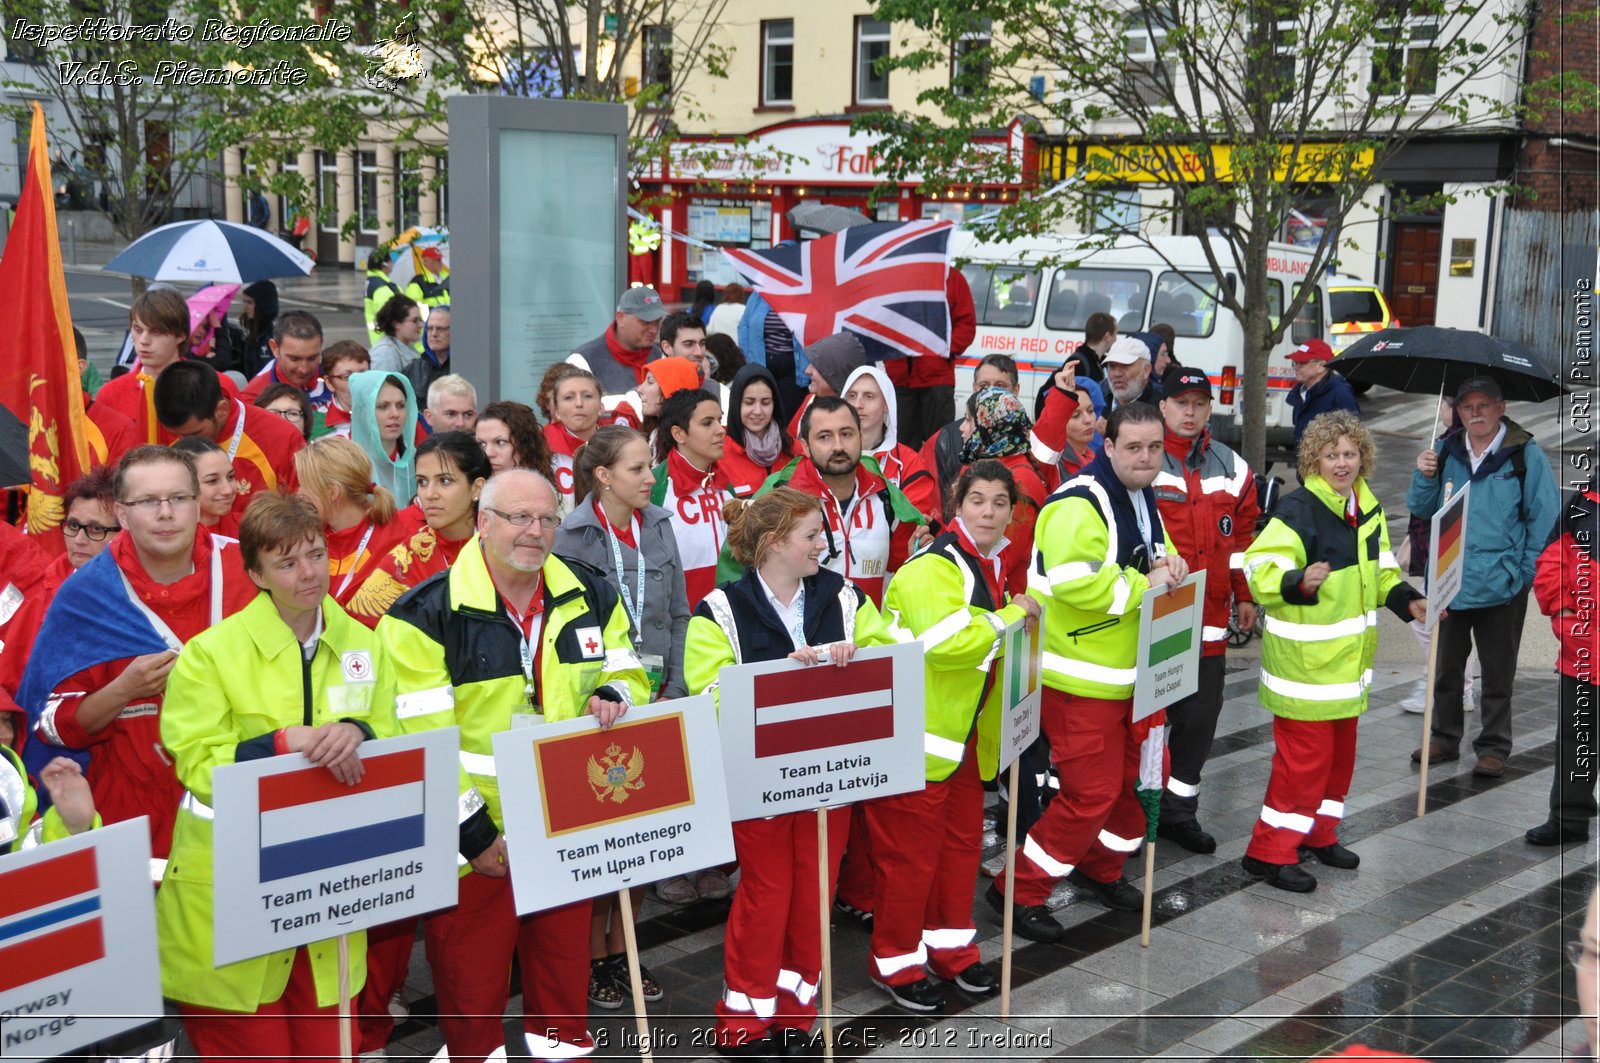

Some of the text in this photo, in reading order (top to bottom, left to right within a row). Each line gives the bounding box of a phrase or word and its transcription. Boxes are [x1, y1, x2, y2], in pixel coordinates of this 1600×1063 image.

[1265, 256, 1312, 275] MBULANC
[981, 335, 1016, 350] IRISH
[1020, 337, 1049, 353] RED
[1154, 663, 1184, 683] Team Hungry
[1166, 678, 1182, 692] Csapat
[780, 755, 871, 780] Team Latvia
[762, 772, 889, 804] Komanda Latvija
[557, 822, 692, 862] Team Montenegro
[571, 846, 684, 882] Тим Црна Гора
[262, 860, 424, 910] Team Netherlands
[271, 885, 415, 933] Team Nederland
[0, 988, 72, 1023] orway
[6, 1014, 77, 1049] Norge
